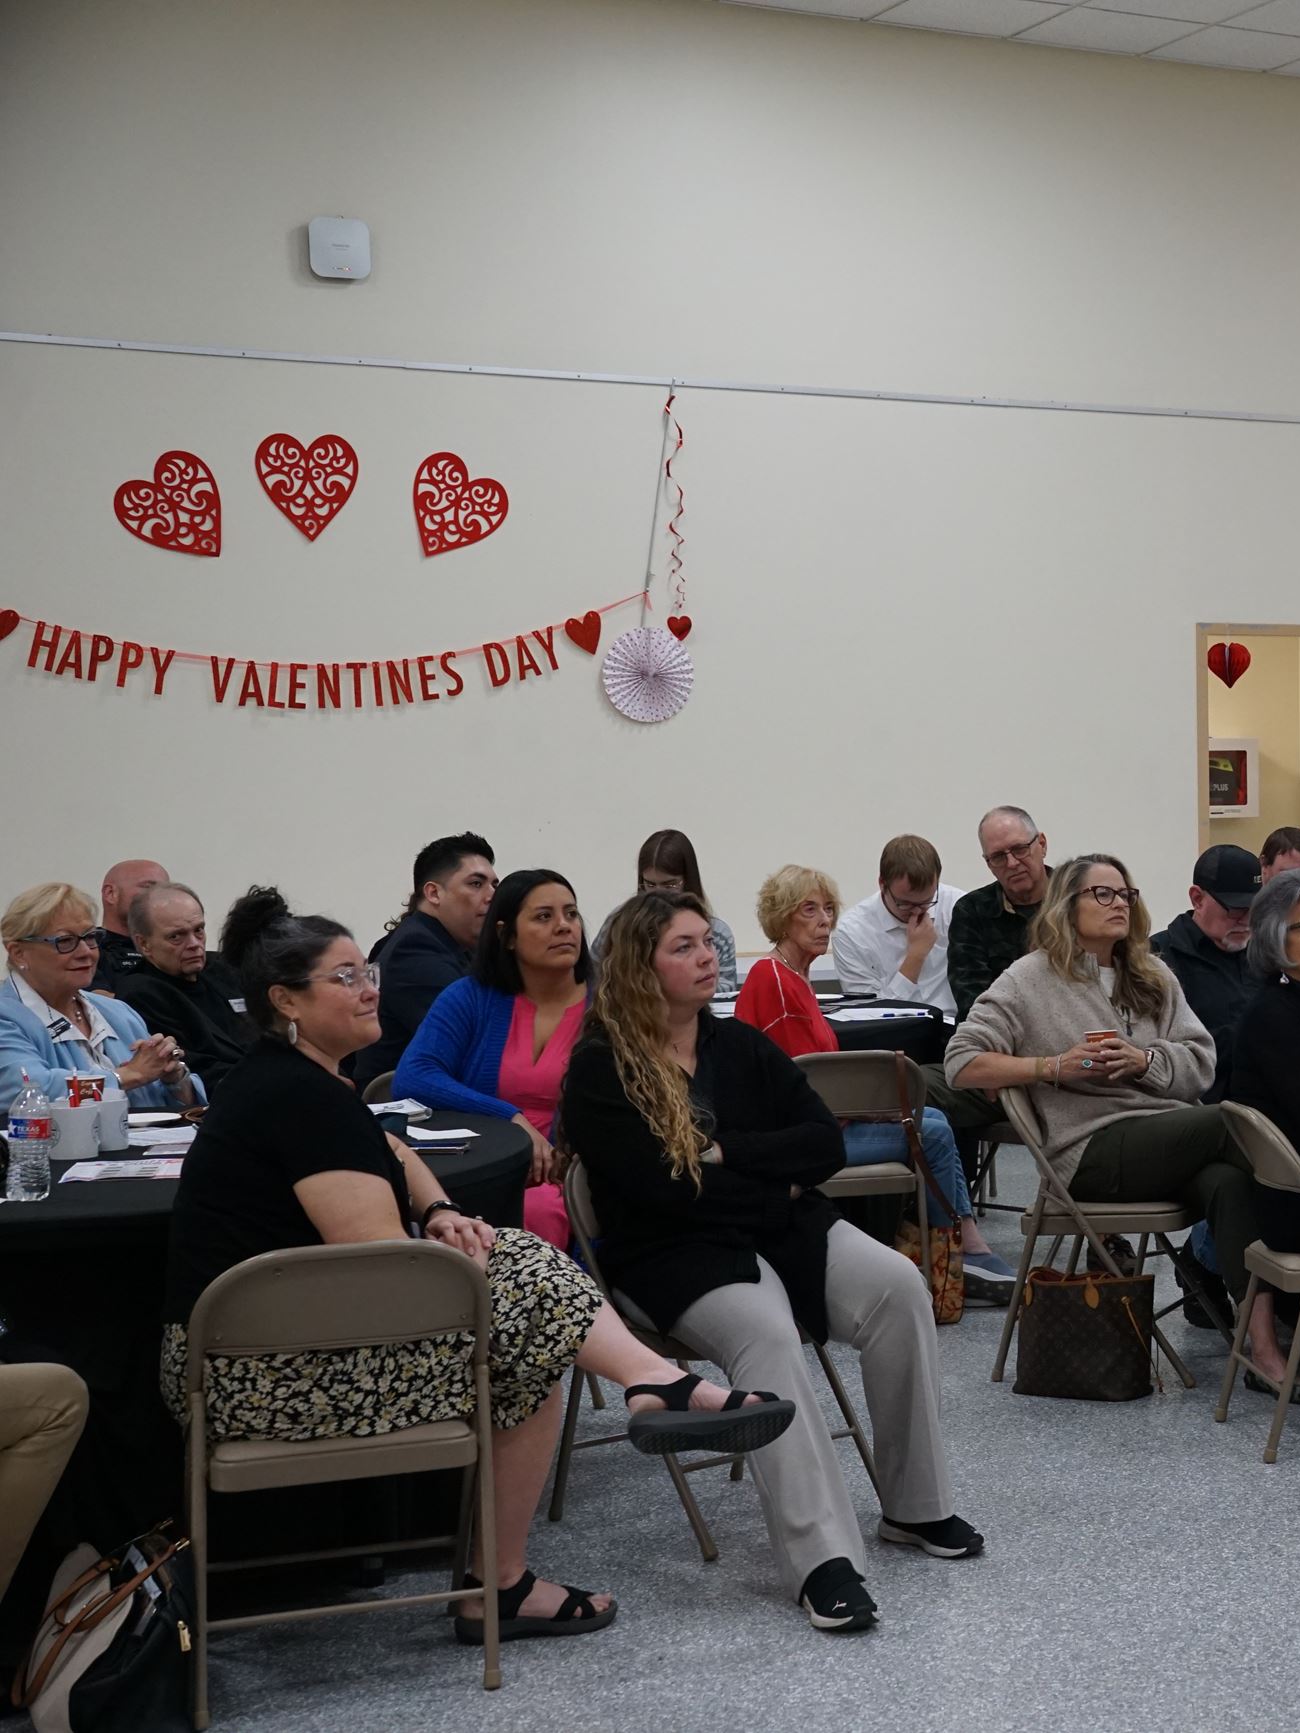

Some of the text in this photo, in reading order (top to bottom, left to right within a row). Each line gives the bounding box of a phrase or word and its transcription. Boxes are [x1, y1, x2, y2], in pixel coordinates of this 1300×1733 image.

[27, 620, 562, 709] HAPPY VALENTINES DAY
